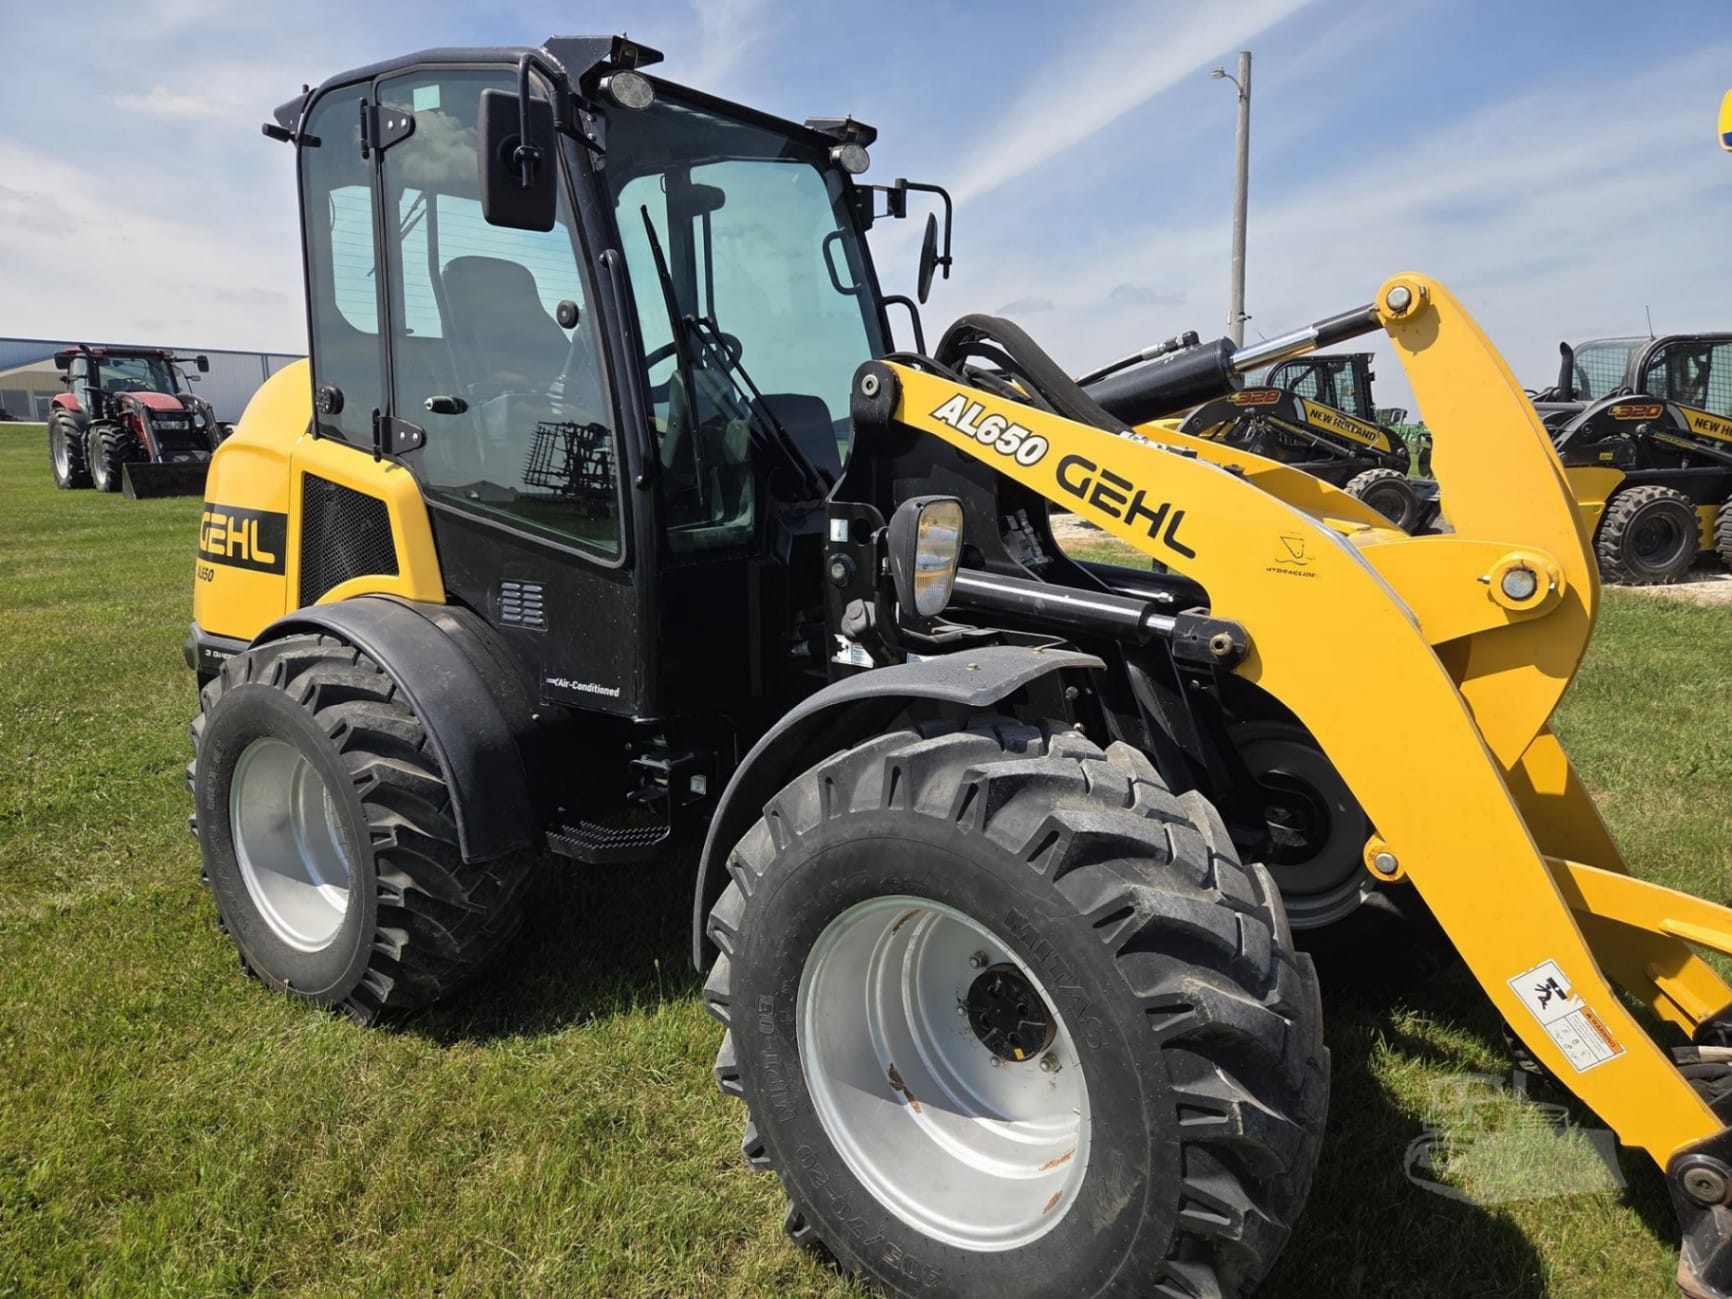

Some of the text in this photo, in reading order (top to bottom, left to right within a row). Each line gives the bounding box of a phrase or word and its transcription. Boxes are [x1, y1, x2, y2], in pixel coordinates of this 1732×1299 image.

[1310, 408, 1333, 424] NEW
[1608, 404, 1663, 420] L320
[929, 393, 1049, 467] AL650
[1694, 417, 1721, 432] NEW
[1056, 454, 1196, 560] GEHL
[200, 511, 275, 564] GEHL
[557, 678, 620, 697] Air-Conditioned
